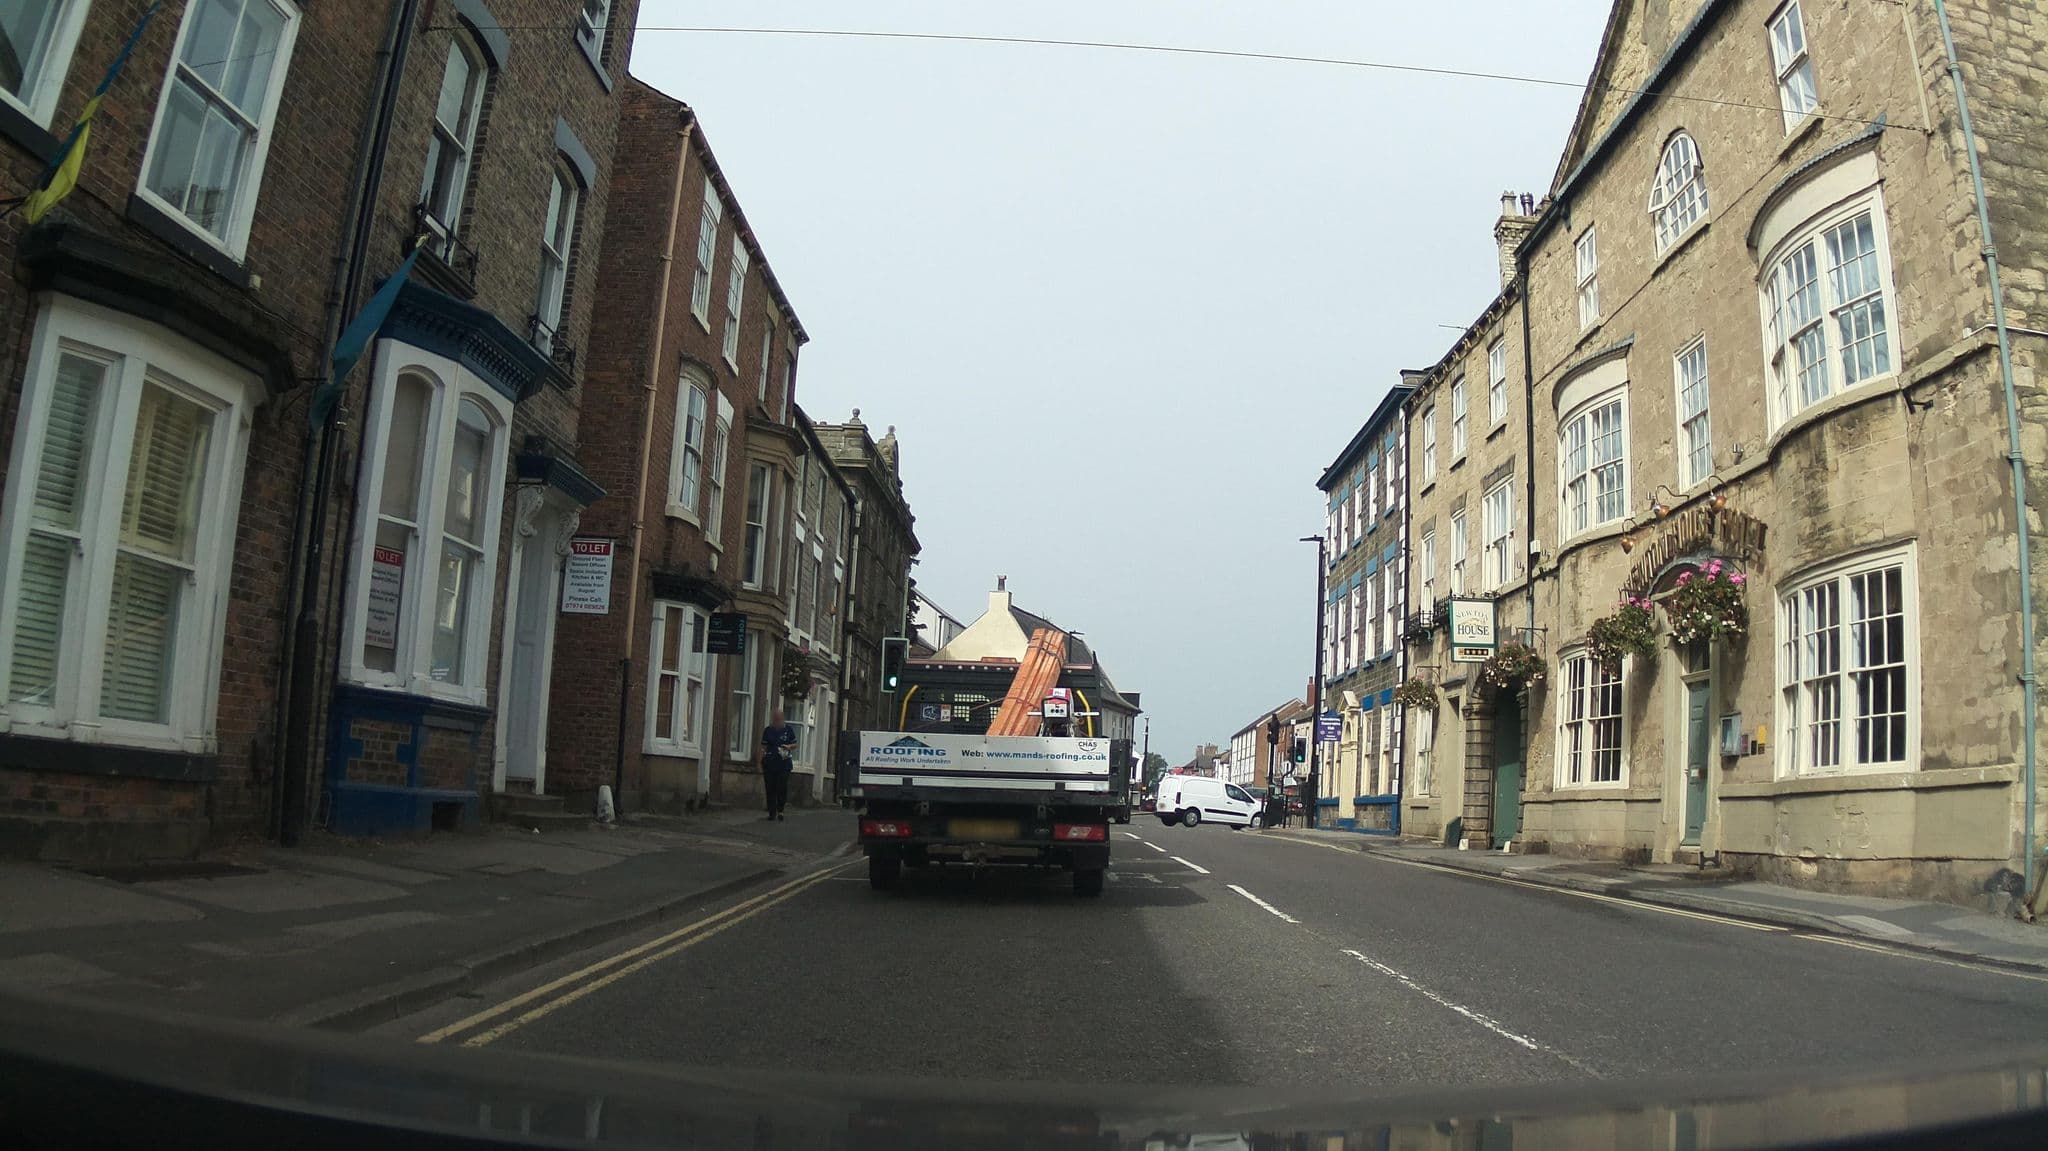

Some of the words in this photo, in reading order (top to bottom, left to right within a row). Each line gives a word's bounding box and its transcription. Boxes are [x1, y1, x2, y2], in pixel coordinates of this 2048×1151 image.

[576, 543, 588, 553] TO
[589, 543, 606, 554] LET
[375, 549, 385, 560] TO
[385, 551, 398, 563] LET
[1456, 609, 1489, 622] NEWTON
[1457, 624, 1490, 636] HOUSE
[870, 747, 946, 757] ROOFING
[961, 749, 984, 758] Web:
[986, 751, 1107, 762] www.mands-roofing.co.uk
[916, 757, 951, 765] Undertaken
